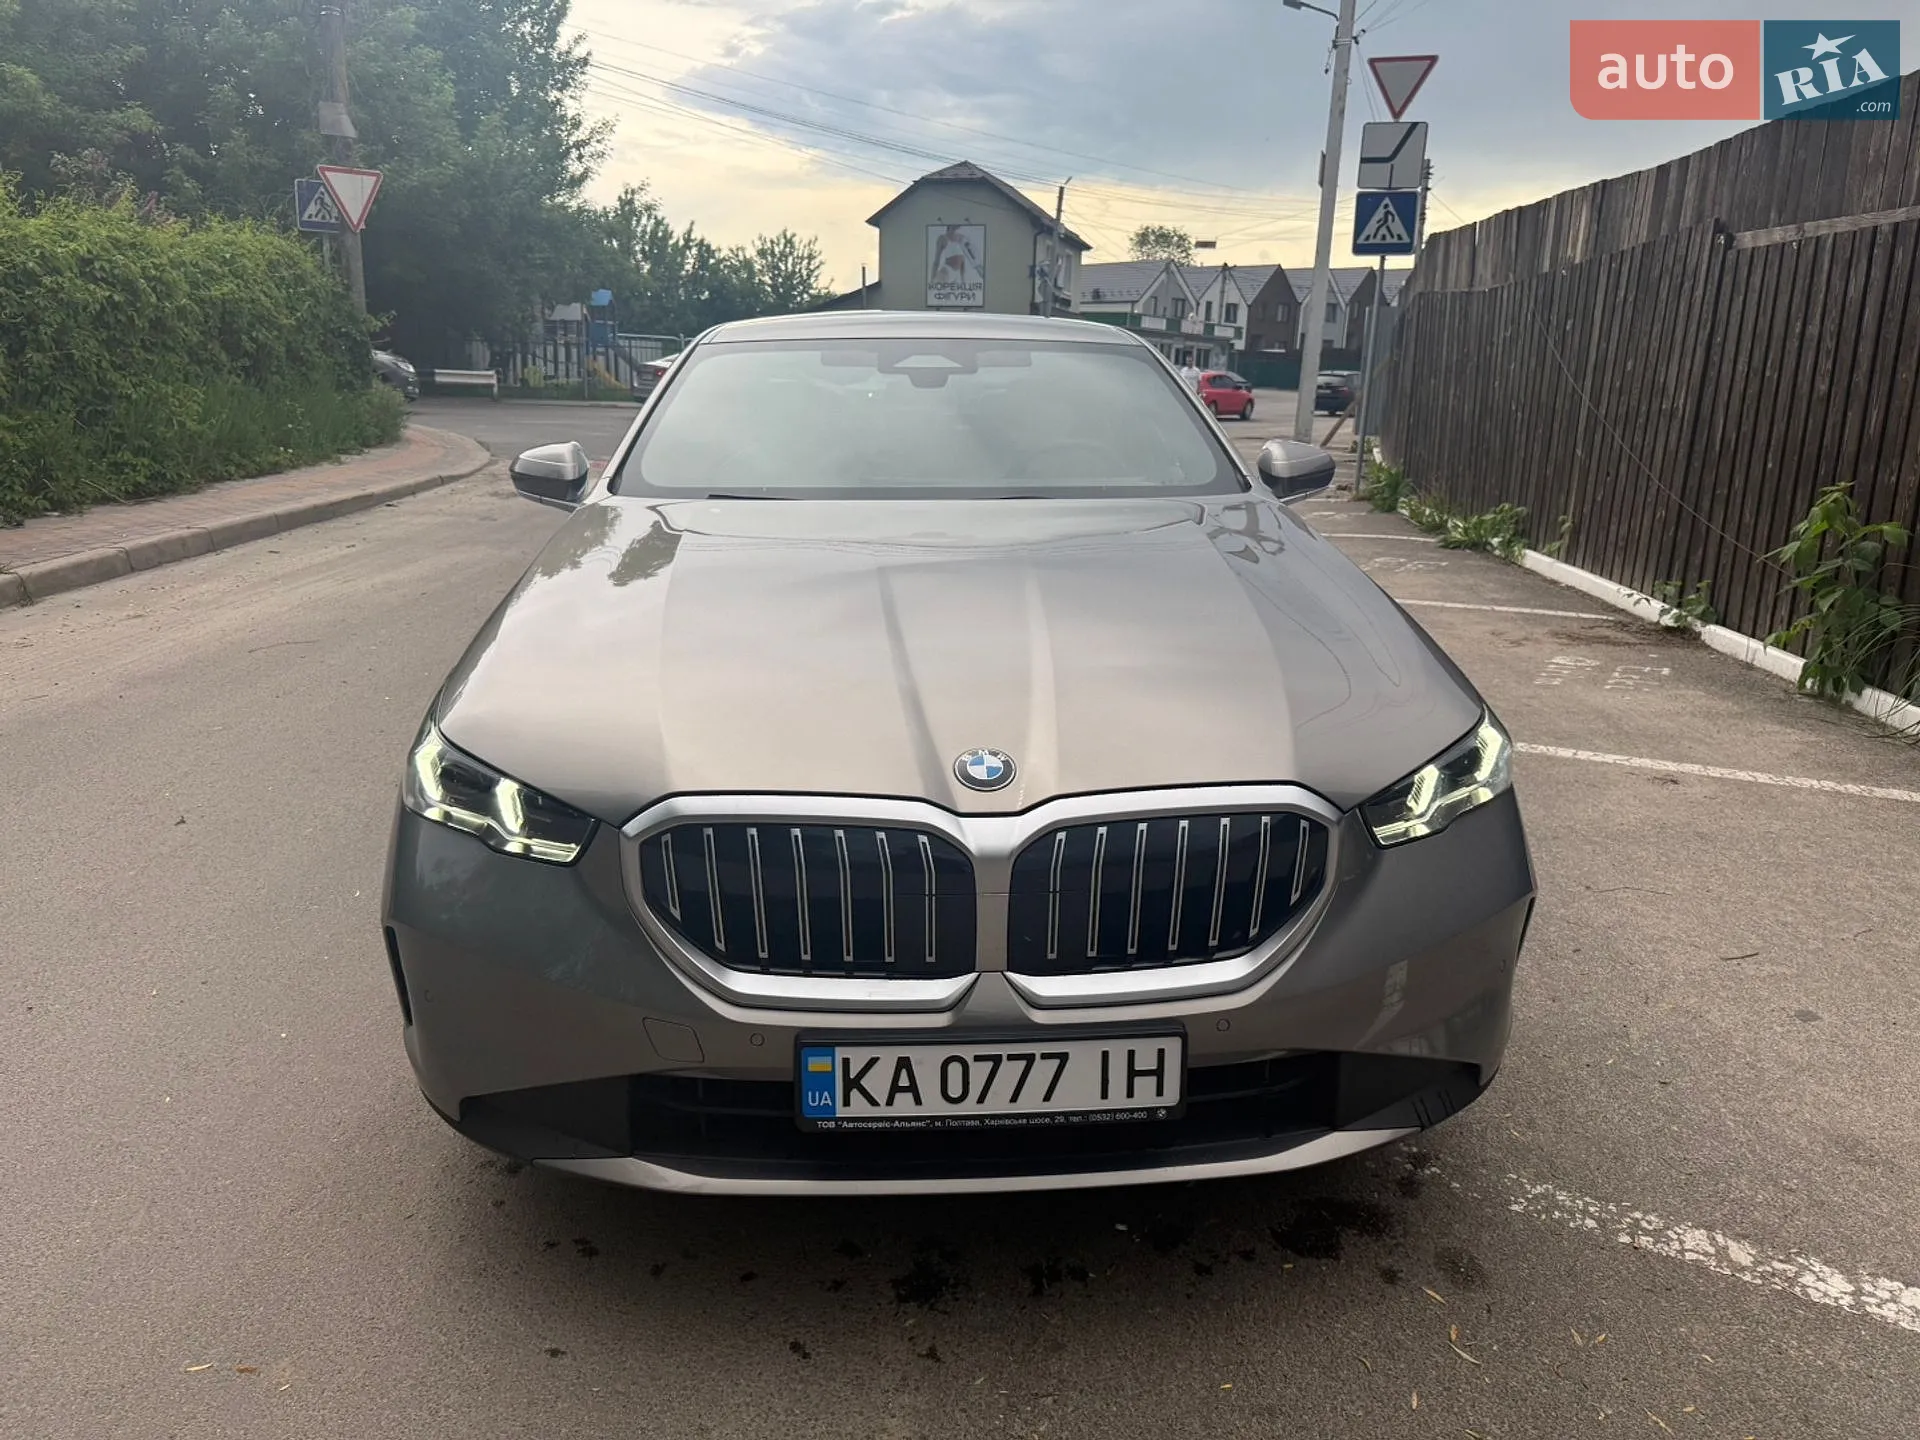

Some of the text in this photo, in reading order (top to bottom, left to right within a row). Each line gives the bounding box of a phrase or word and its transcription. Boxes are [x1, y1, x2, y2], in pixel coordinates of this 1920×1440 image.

[841, 1047, 1165, 1107] KA 0777 IH
[807, 1091, 833, 1107] UA
